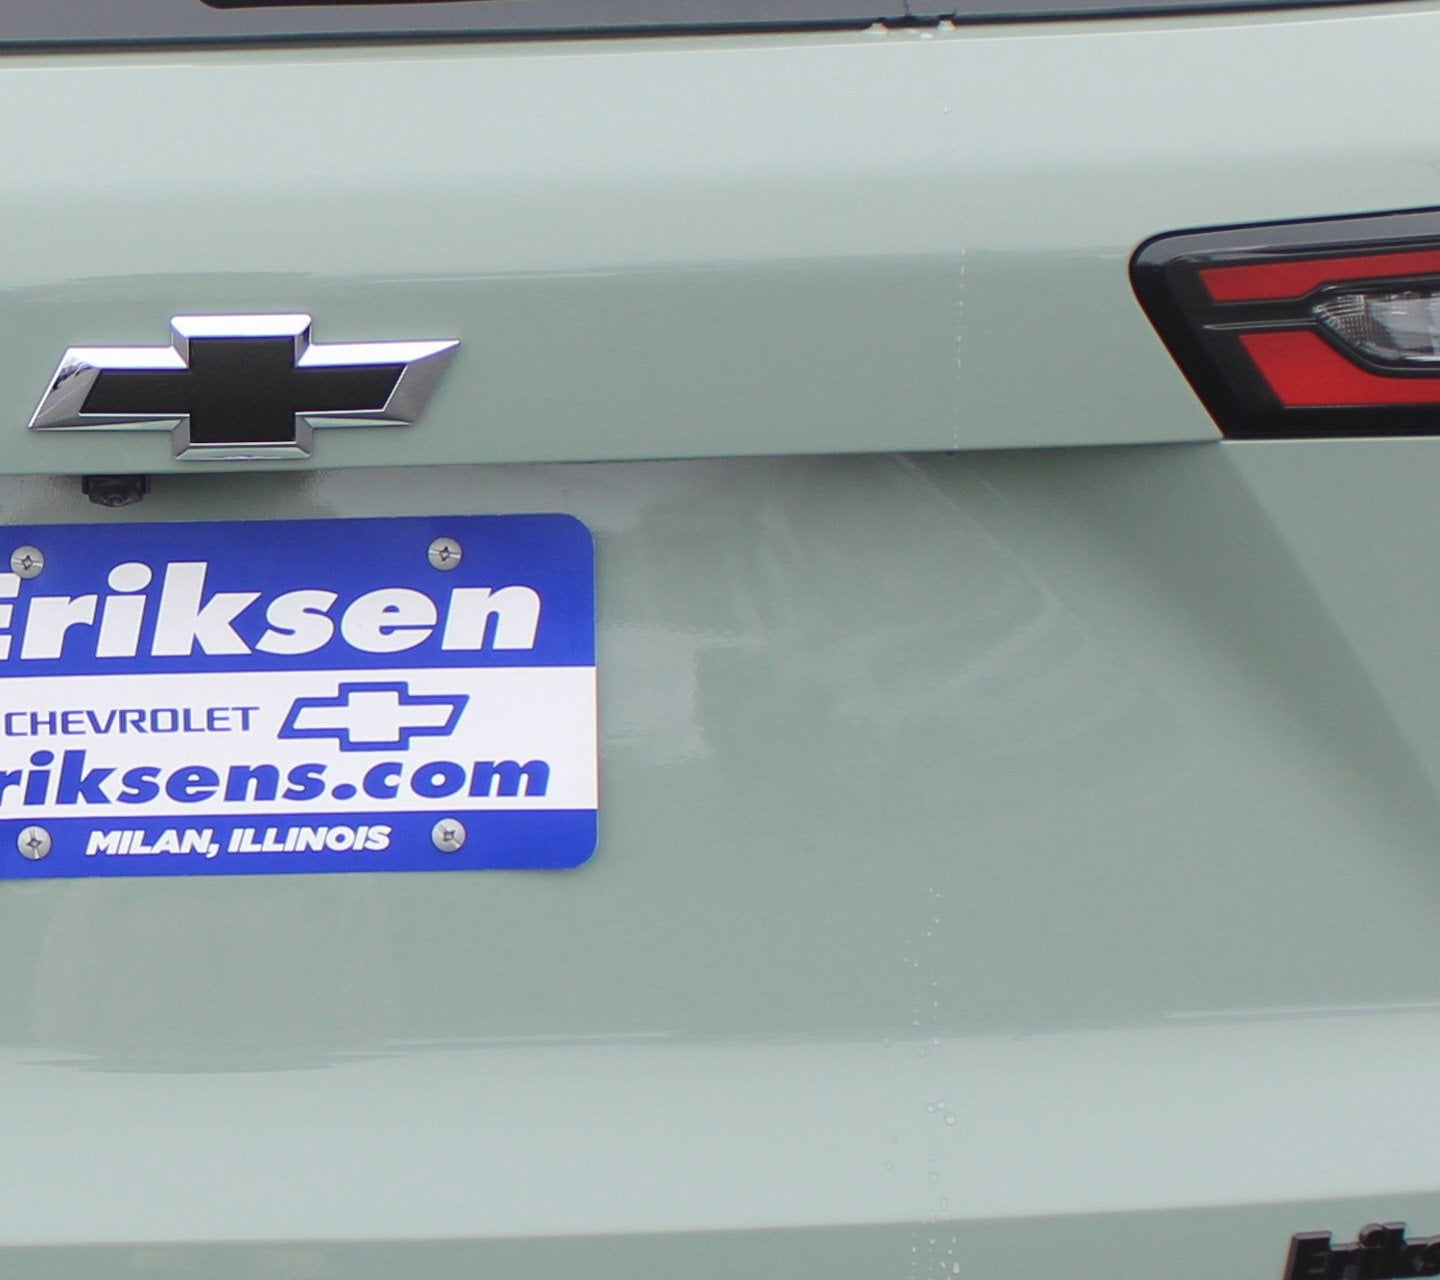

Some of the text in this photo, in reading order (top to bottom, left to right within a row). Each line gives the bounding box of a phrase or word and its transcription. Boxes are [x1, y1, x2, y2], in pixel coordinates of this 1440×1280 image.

[4, 706, 261, 738] CHEVROLET
[85, 825, 392, 859] MILAN, ILLINOIS
